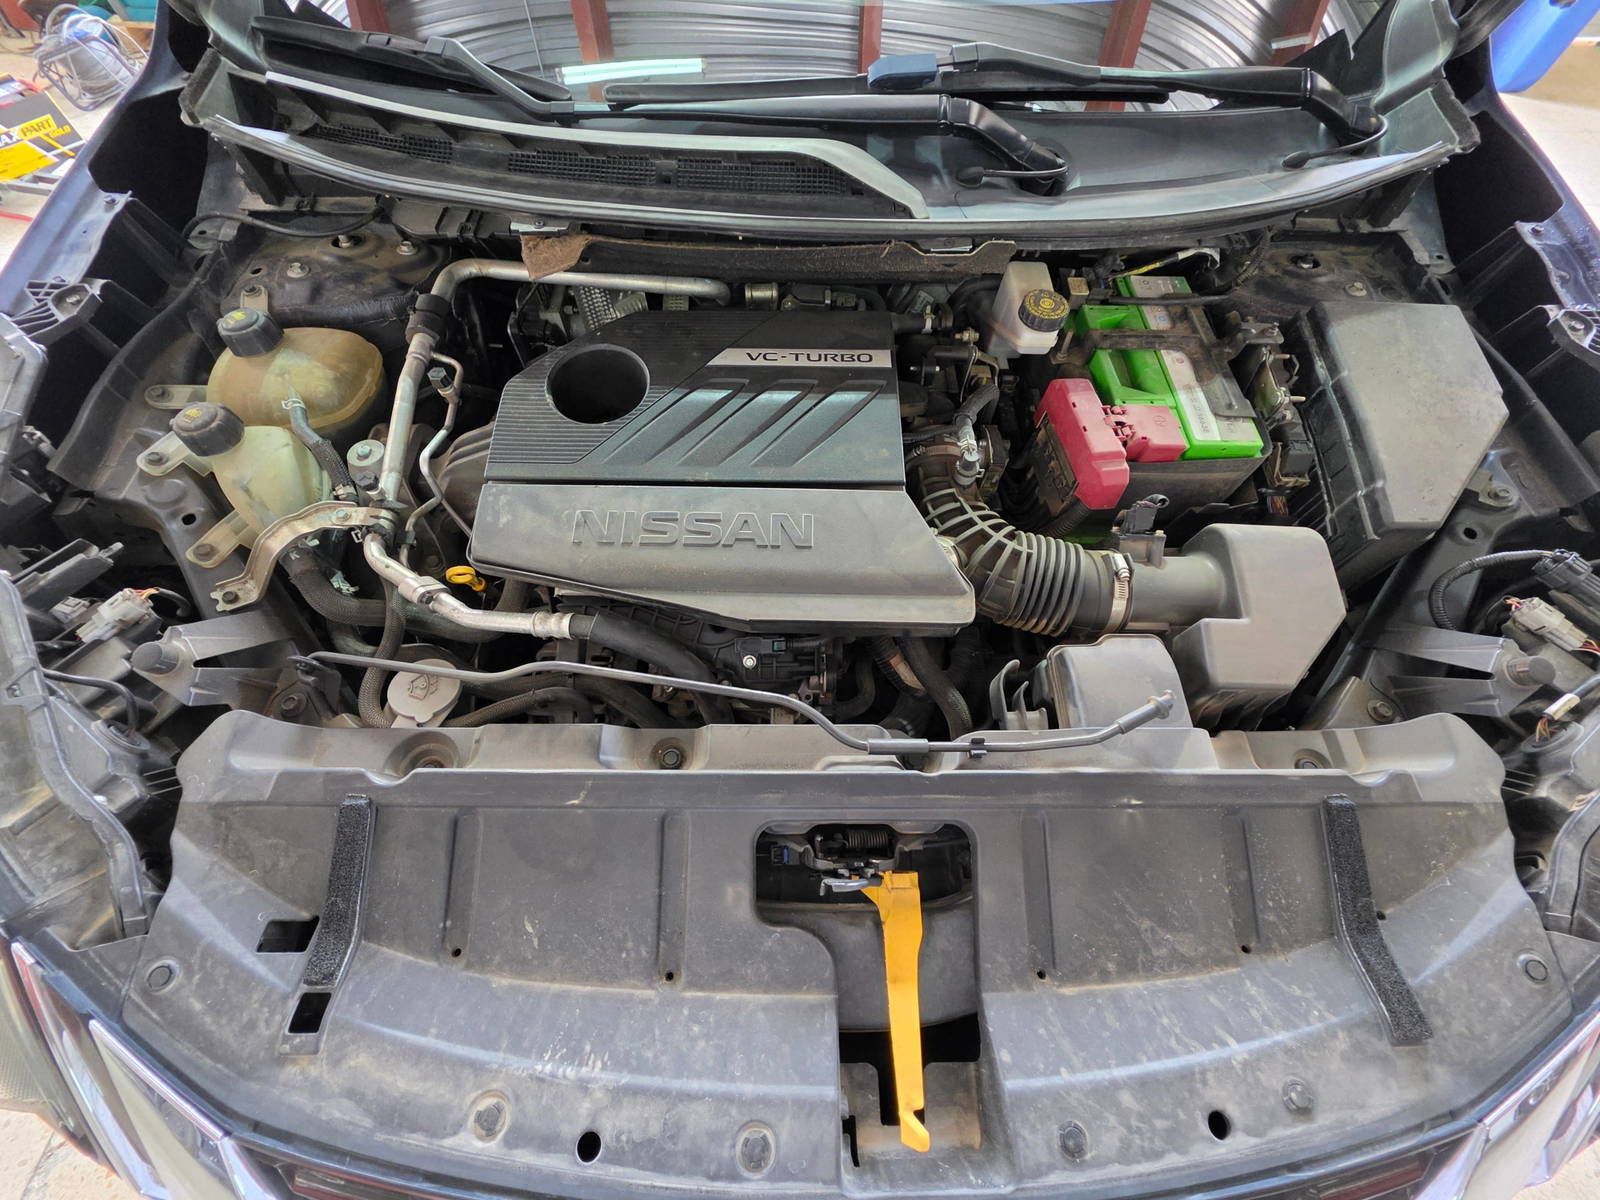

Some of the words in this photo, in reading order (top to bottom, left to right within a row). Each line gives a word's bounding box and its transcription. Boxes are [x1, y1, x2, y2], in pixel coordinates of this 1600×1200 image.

[20, 119, 52, 137] PART
[746, 352, 873, 363] VC-TURBO
[572, 510, 815, 549] NISSAN
